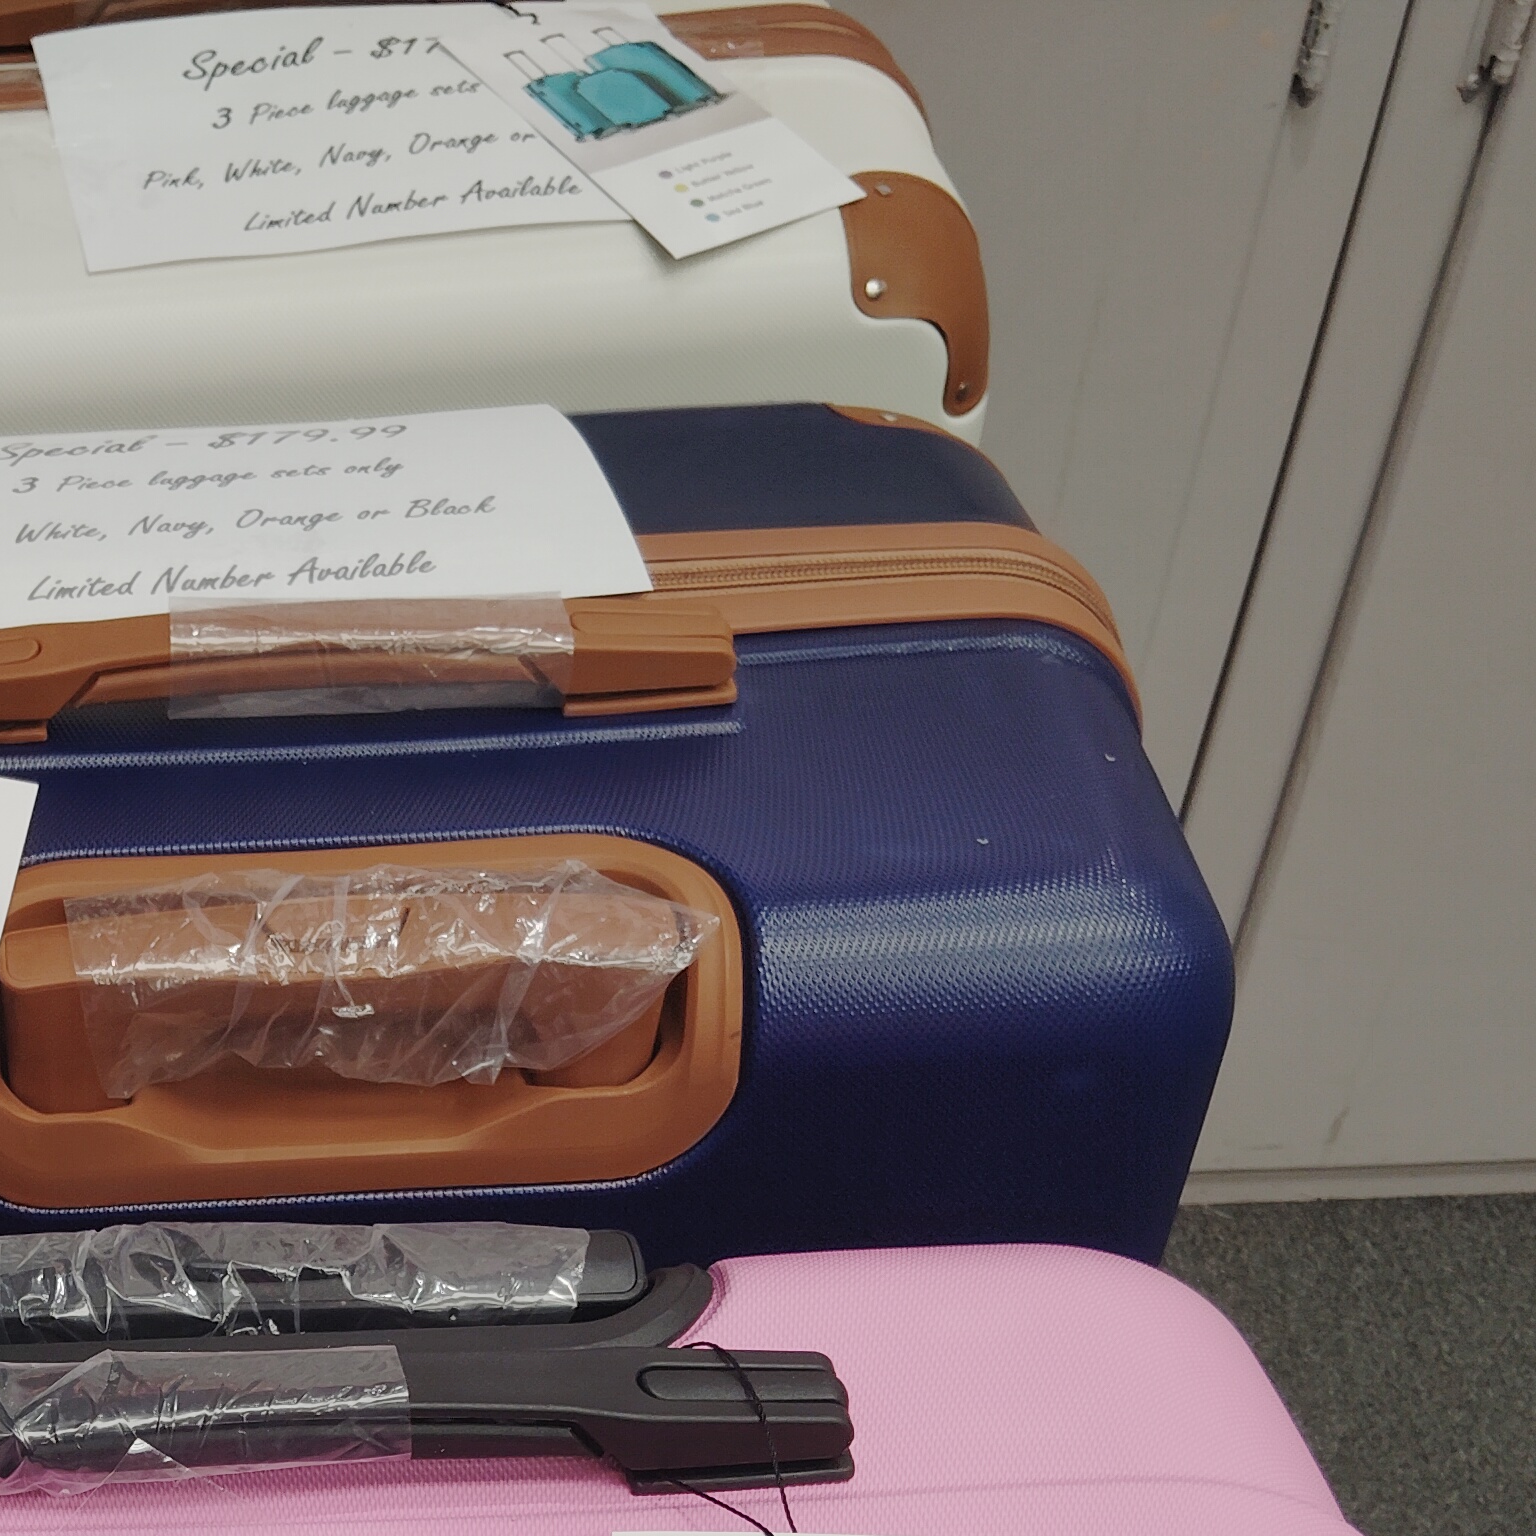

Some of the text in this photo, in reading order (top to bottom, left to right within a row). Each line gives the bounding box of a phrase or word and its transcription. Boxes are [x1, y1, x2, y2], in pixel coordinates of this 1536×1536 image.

[182, 36, 324, 92] Special
[212, 79, 482, 130] 3 Piece luggage sets
[142, 131, 537, 190] Pink, White, Navy, Orange or
[244, 175, 583, 233] Limited Number Available
[207, 424, 408, 450] $179.99
[12, 456, 405, 493] 3 Piece luggage sets only
[14, 520, 108, 543] White,
[127, 513, 215, 540] Navy,
[235, 508, 344, 532] Orange
[356, 507, 391, 520] or
[404, 495, 497, 519] Black
[26, 549, 437, 602] Limited Number Available
